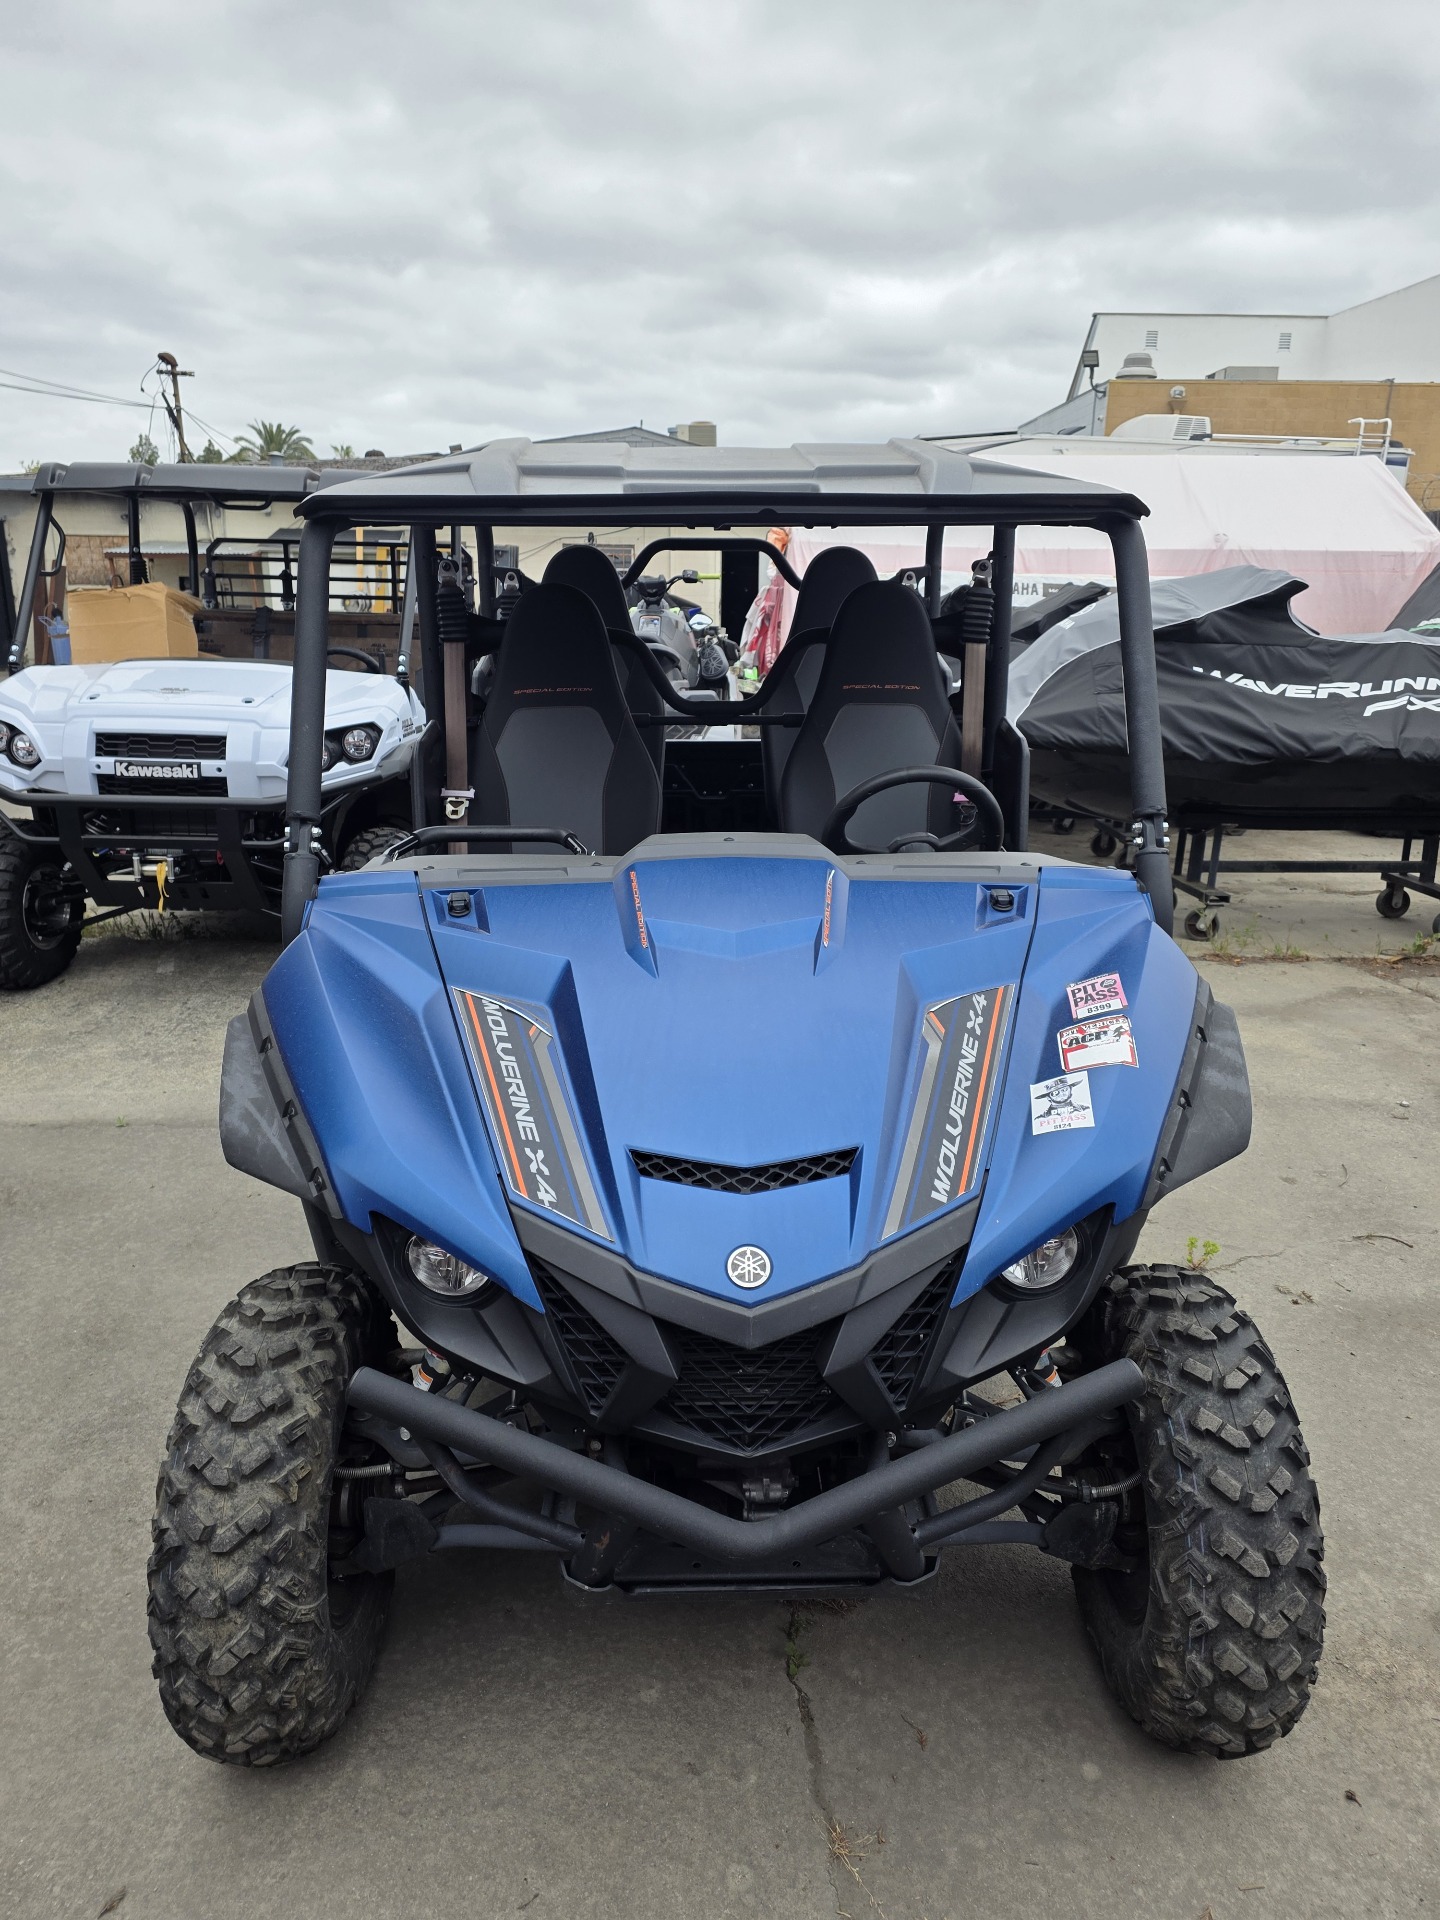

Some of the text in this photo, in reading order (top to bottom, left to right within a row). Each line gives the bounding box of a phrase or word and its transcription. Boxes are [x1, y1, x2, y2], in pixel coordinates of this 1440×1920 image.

[115, 762, 199, 779] Kawasaki
[630, 871, 642, 911] SPECIAL
[1071, 981, 1099, 999] PIT
[1073, 987, 1120, 1008] PASS
[1087, 1002, 1112, 1014] 8399
[482, 999, 541, 1143] WOLVERINE
[930, 993, 988, 1204] WOLVERINE X4
[1040, 1113, 1087, 1128] PIT PASS
